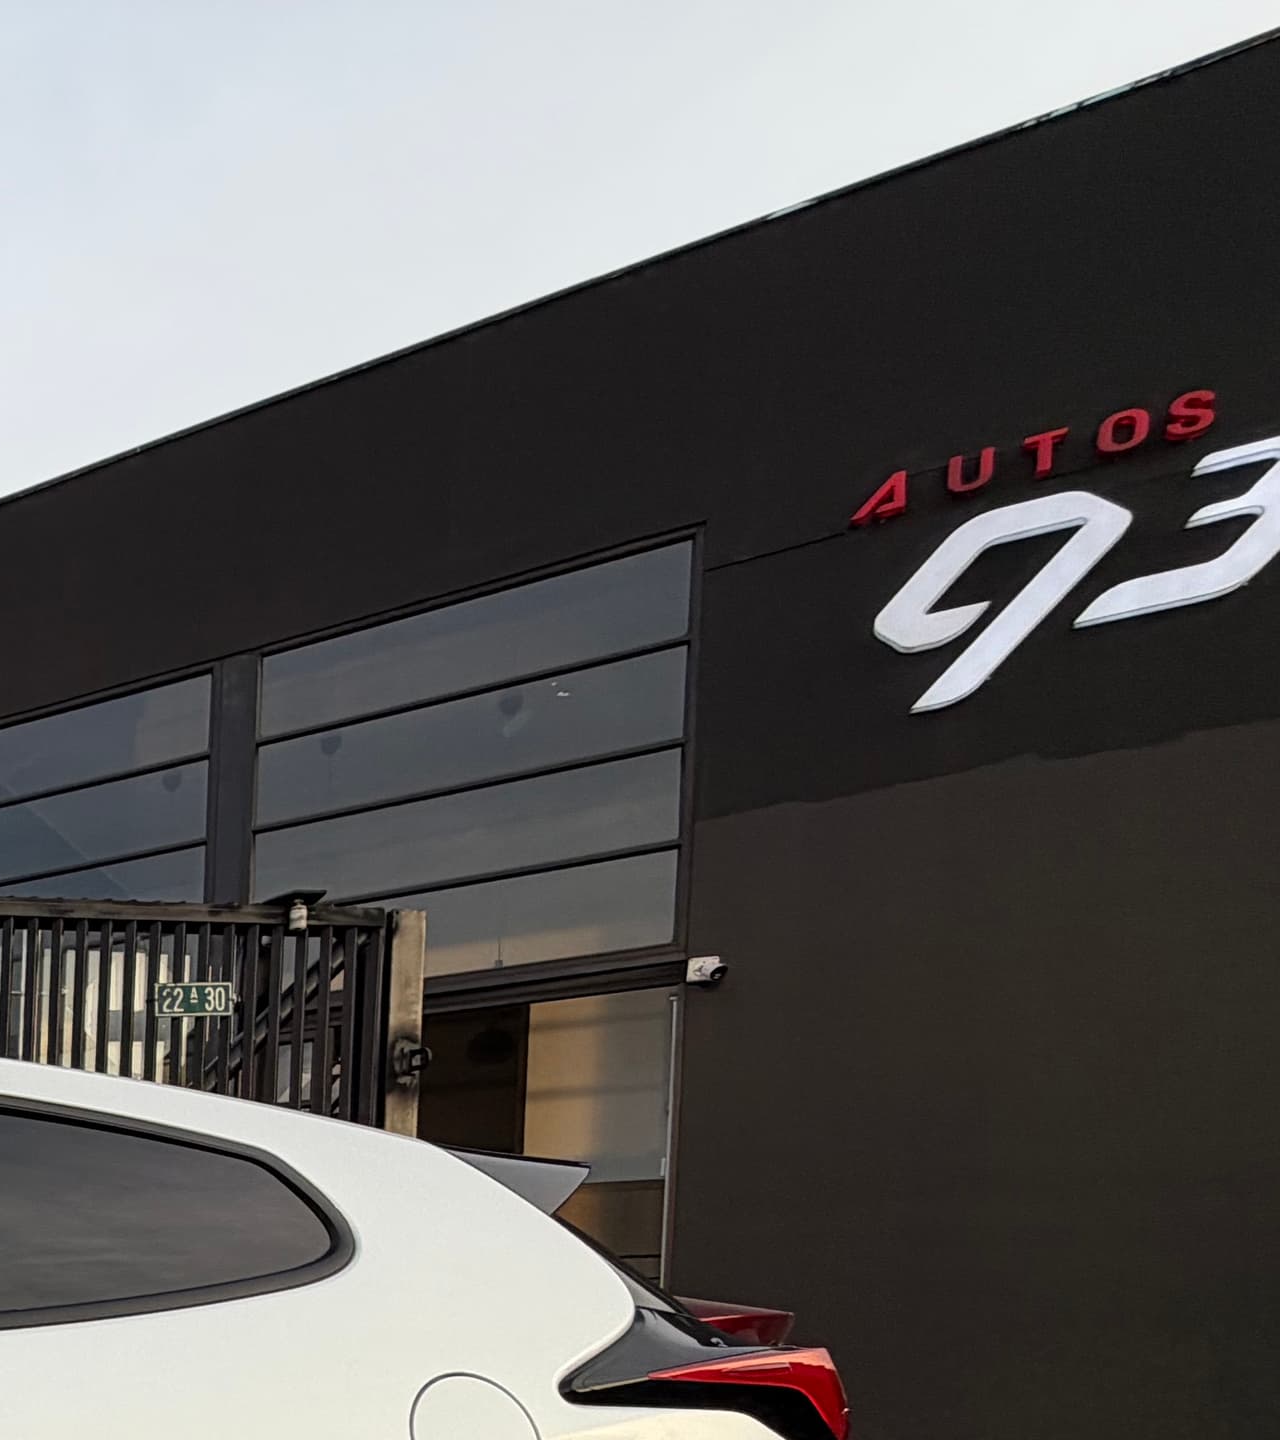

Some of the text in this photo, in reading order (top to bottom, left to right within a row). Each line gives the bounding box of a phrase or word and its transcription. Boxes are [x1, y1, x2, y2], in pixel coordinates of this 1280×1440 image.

[849, 390, 1216, 528] AUTOS
[874, 436, 1280, 714] 93
[162, 987, 226, 1012] 22 A 30
